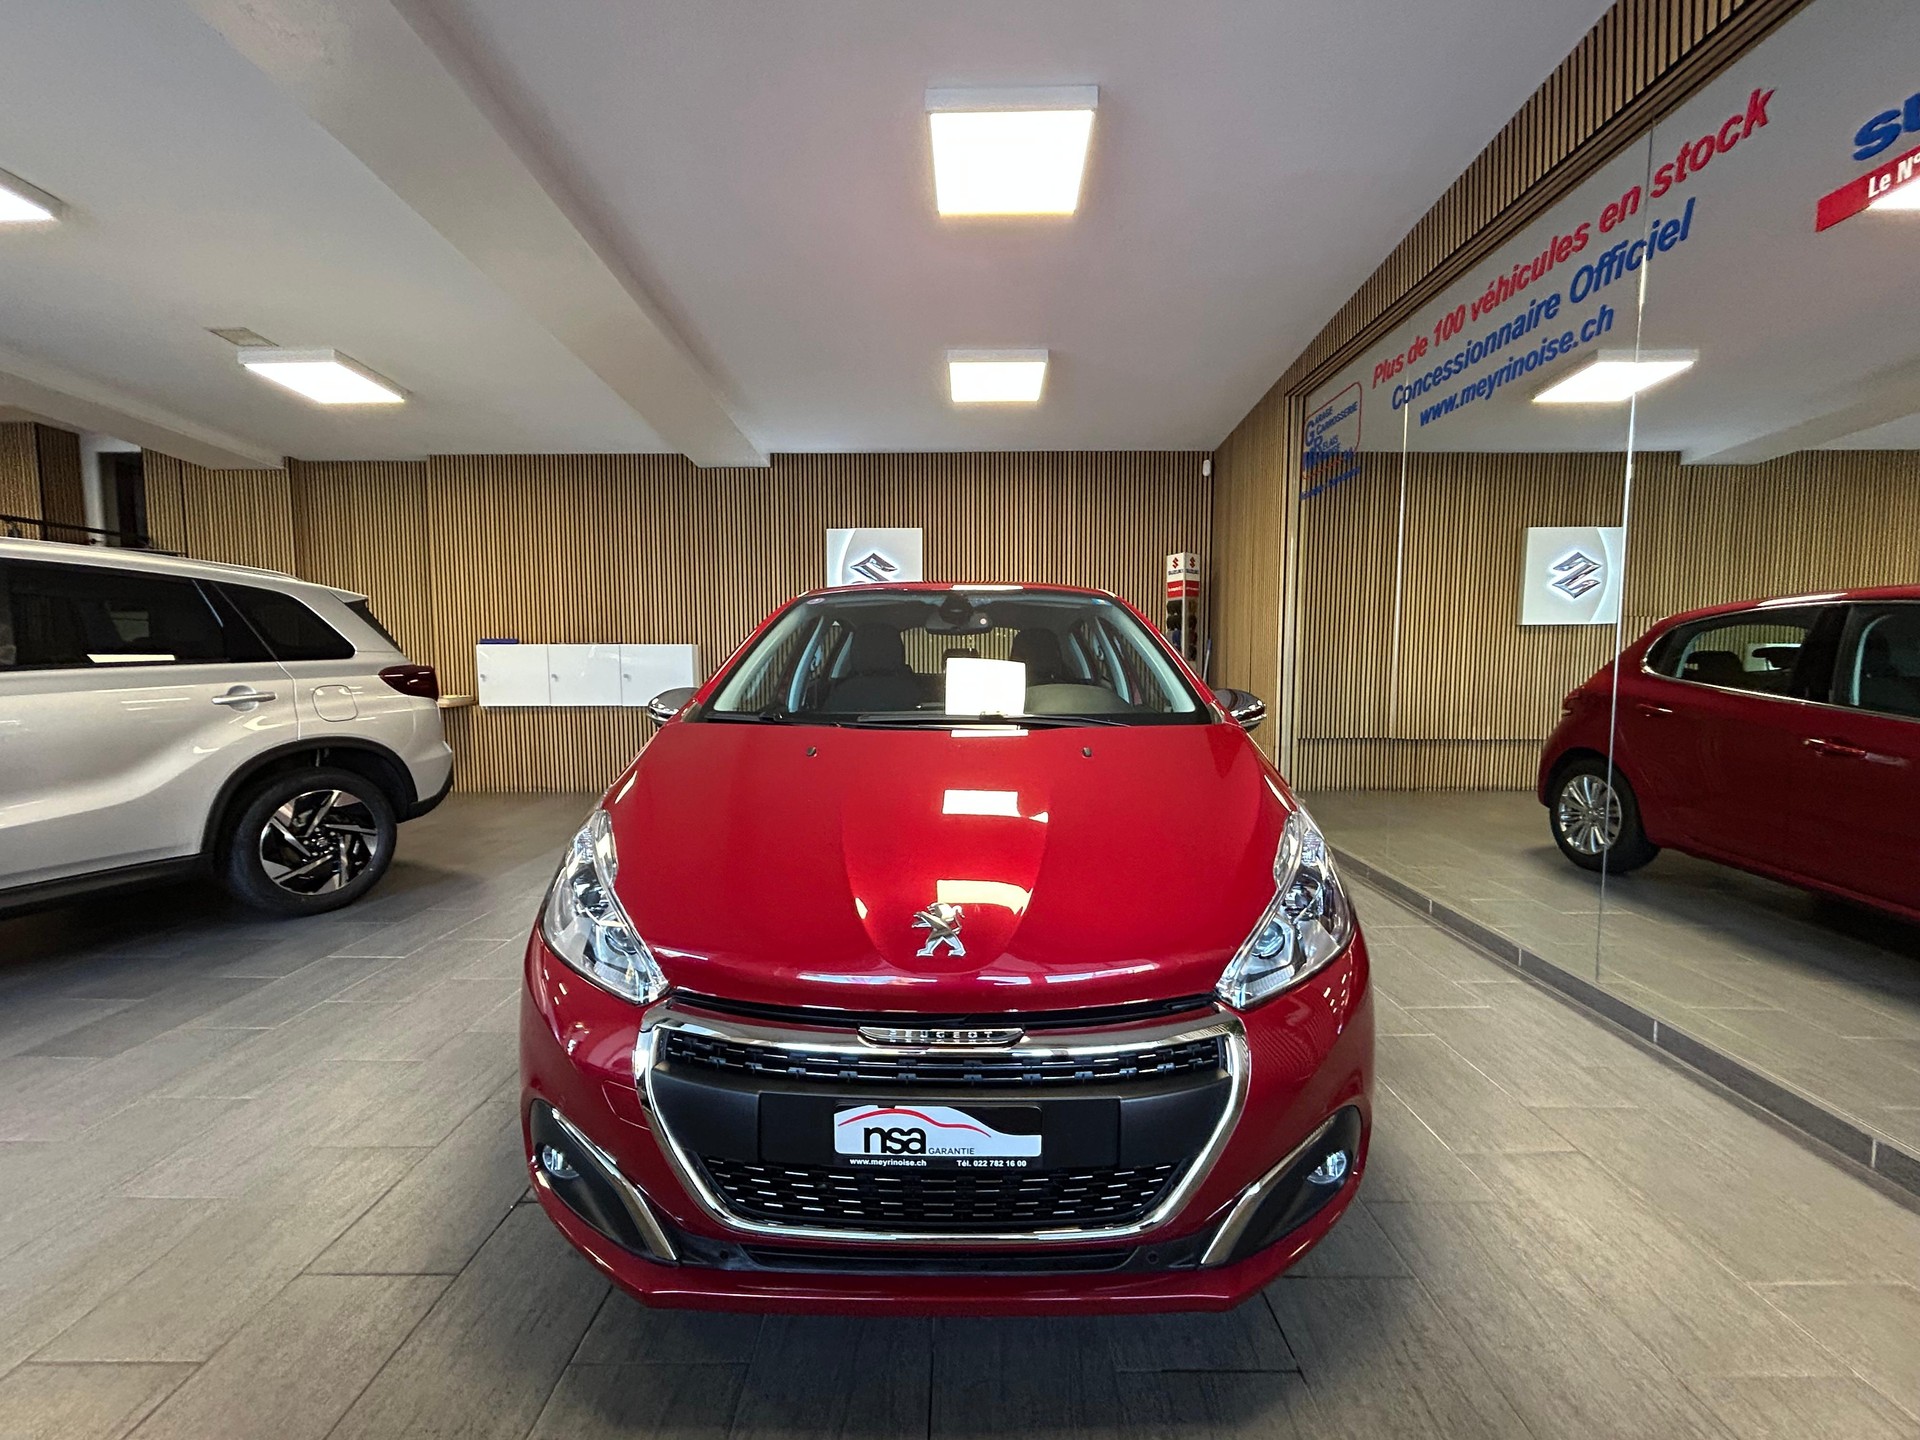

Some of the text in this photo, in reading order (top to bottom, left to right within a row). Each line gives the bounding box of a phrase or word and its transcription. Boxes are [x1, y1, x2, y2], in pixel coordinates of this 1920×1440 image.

[1868, 173, 1891, 198] Le
[1372, 88, 1776, 390] Plus de 100 véhicules en stock
[1391, 197, 1696, 410] Concessionnaire Officiel
[1420, 304, 1614, 427] www.meyrinoise.ch
[888, 1029, 993, 1042] PEUGEOT
[864, 1127, 927, 1155] nsa
[928, 1147, 975, 1155] GARANTIE
[849, 1158, 927, 1167] www.meyrinoise.ch
[956, 1159, 972, 1167] Tél.
